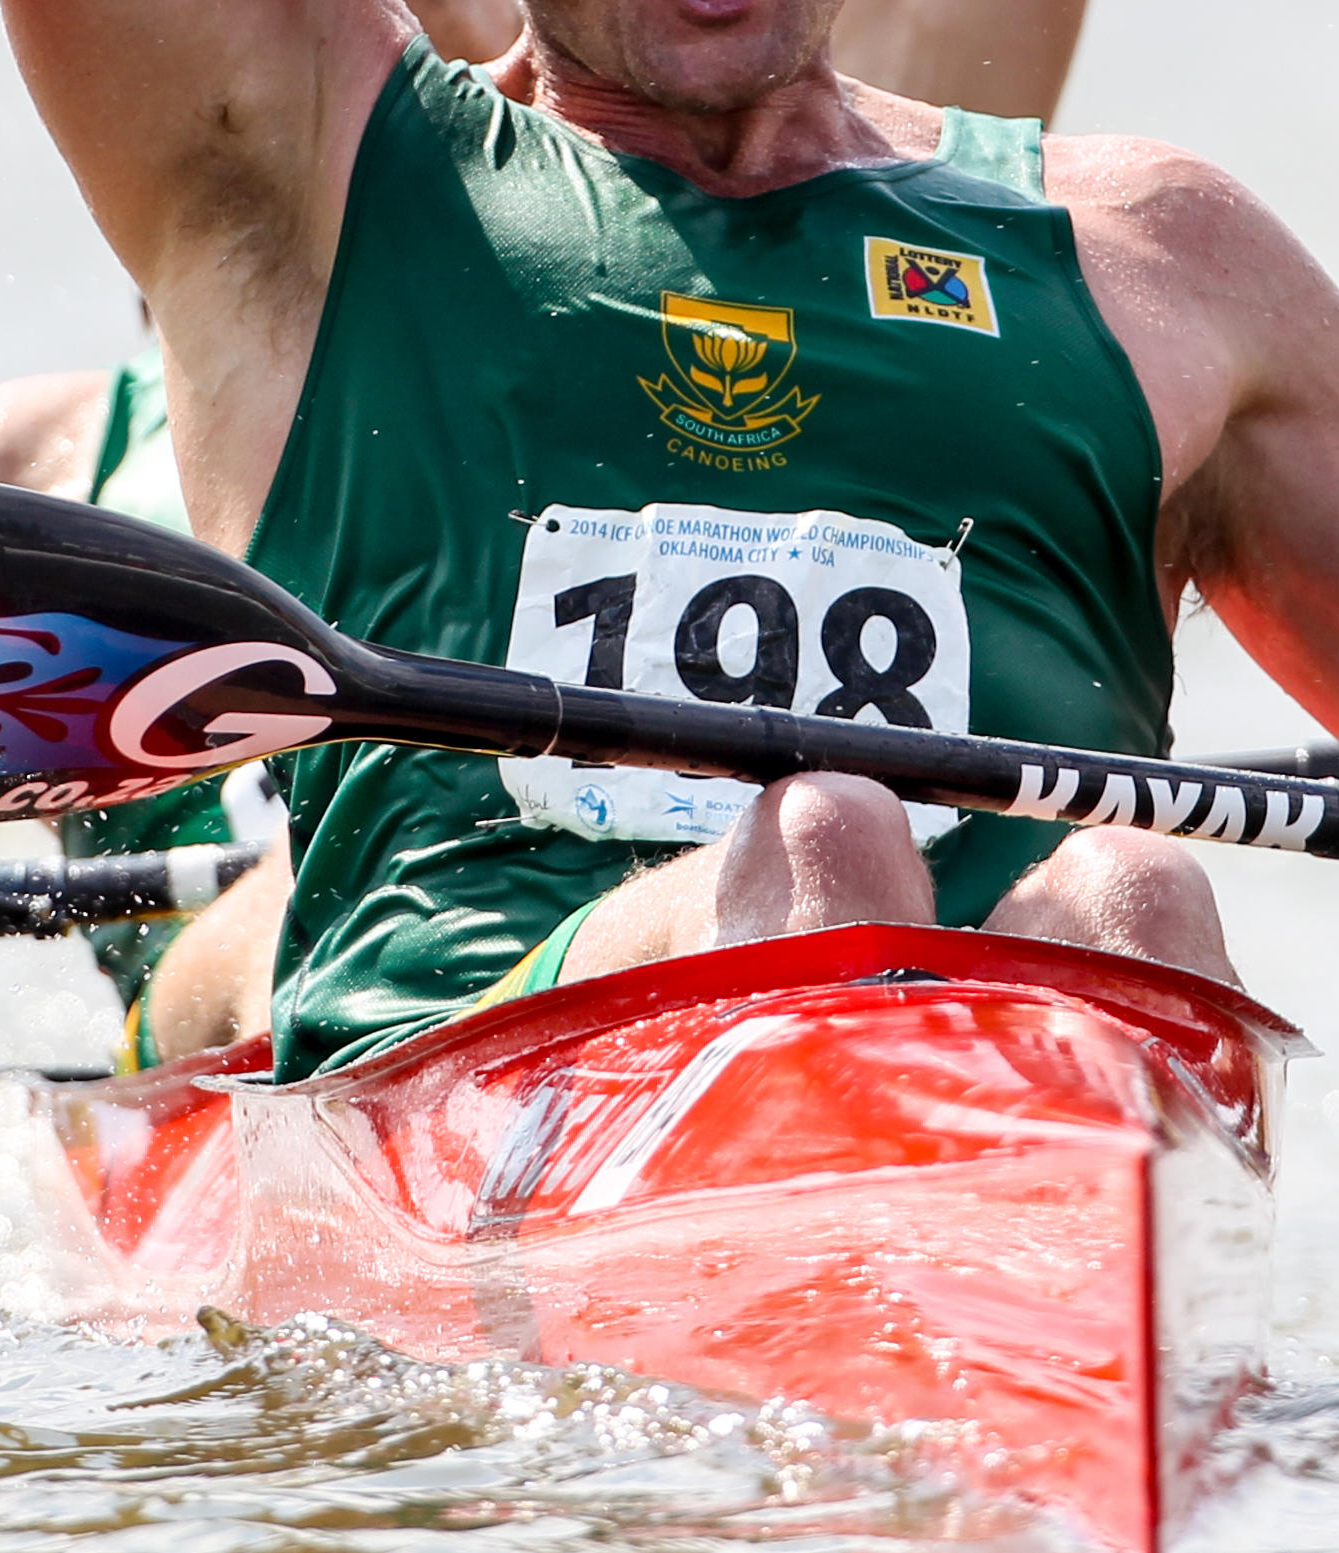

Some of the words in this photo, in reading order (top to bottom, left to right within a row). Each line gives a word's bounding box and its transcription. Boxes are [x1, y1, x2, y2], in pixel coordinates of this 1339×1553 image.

[675, 413, 724, 443] SOUTH
[727, 427, 782, 445] AFRICA
[666, 438, 788, 472] CANOEING
[570, 519, 608, 538] 2014
[611, 524, 633, 542] ICF
[678, 519, 763, 543] MARATHON
[766, 524, 819, 543] WOD
[659, 541, 743, 564] OKLAHOMA
[748, 548, 778, 564] CITY
[812, 548, 835, 567] USA
[554, 573, 937, 770] 198
[111, 642, 337, 768] G
[998, 764, 1325, 851] KAYAK
